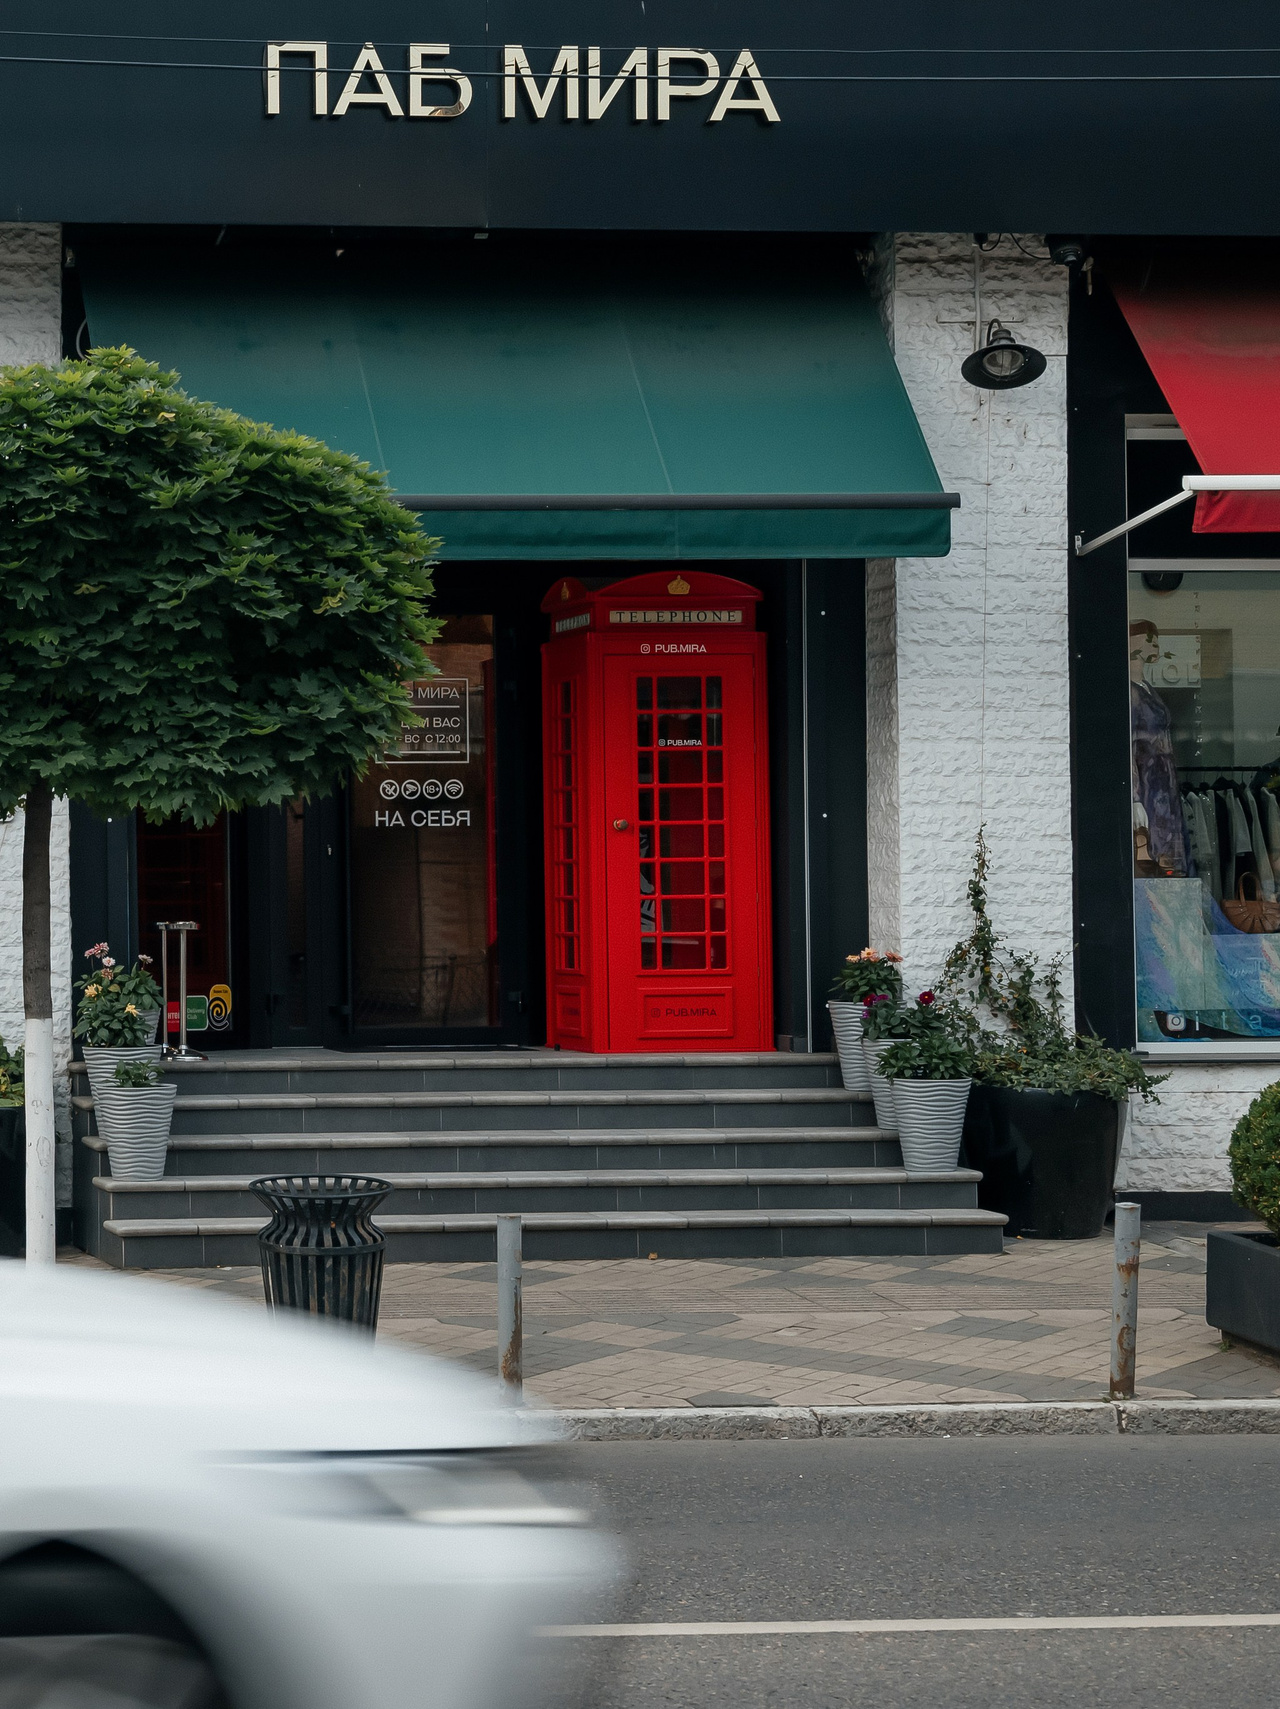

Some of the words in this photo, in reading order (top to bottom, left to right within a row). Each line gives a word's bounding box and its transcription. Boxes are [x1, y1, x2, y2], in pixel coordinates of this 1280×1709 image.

[263, 39, 473, 118] ПАБ
[502, 43, 782, 123] МИРА
[616, 611, 737, 622] TELEPHONE
[655, 644, 707, 653] PUB.MIRA
[417, 686, 460, 699] МИРА
[432, 716, 461, 729] ВАС
[404, 733, 420, 744] ВС
[435, 733, 461, 744] 12:00
[666, 739, 703, 747] PUB.MIRA
[425, 785, 440, 794] 18+
[374, 810, 406, 827] НА
[410, 809, 471, 827] СЕБЯ
[665, 1008, 717, 1017] PUB.MIRA
